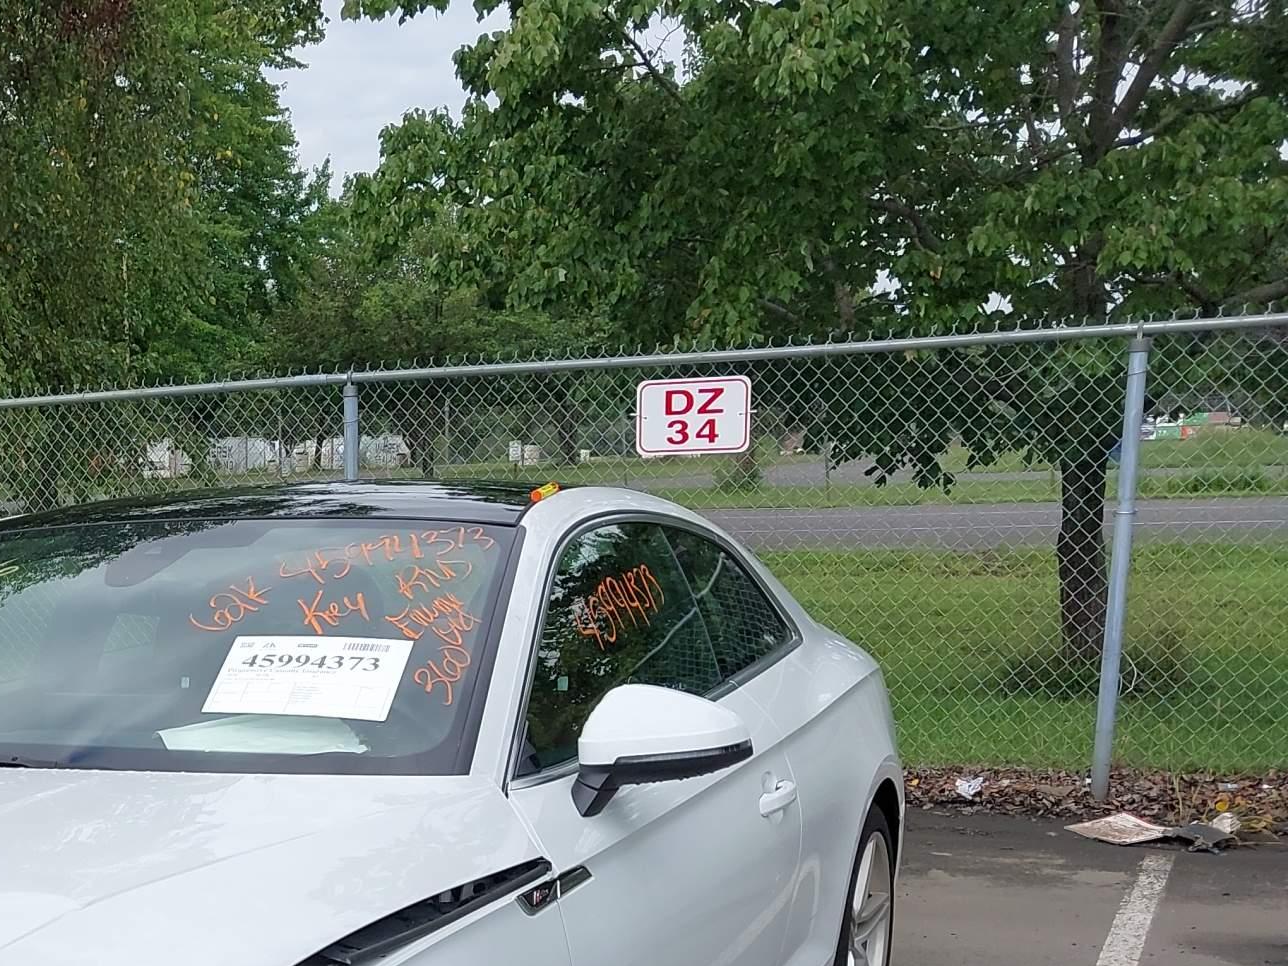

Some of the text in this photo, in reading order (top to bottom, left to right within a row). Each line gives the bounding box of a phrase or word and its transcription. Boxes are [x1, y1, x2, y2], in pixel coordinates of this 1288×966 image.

[664, 387, 725, 416] DZ
[666, 418, 720, 445] 34
[241, 653, 381, 672] 45994373
